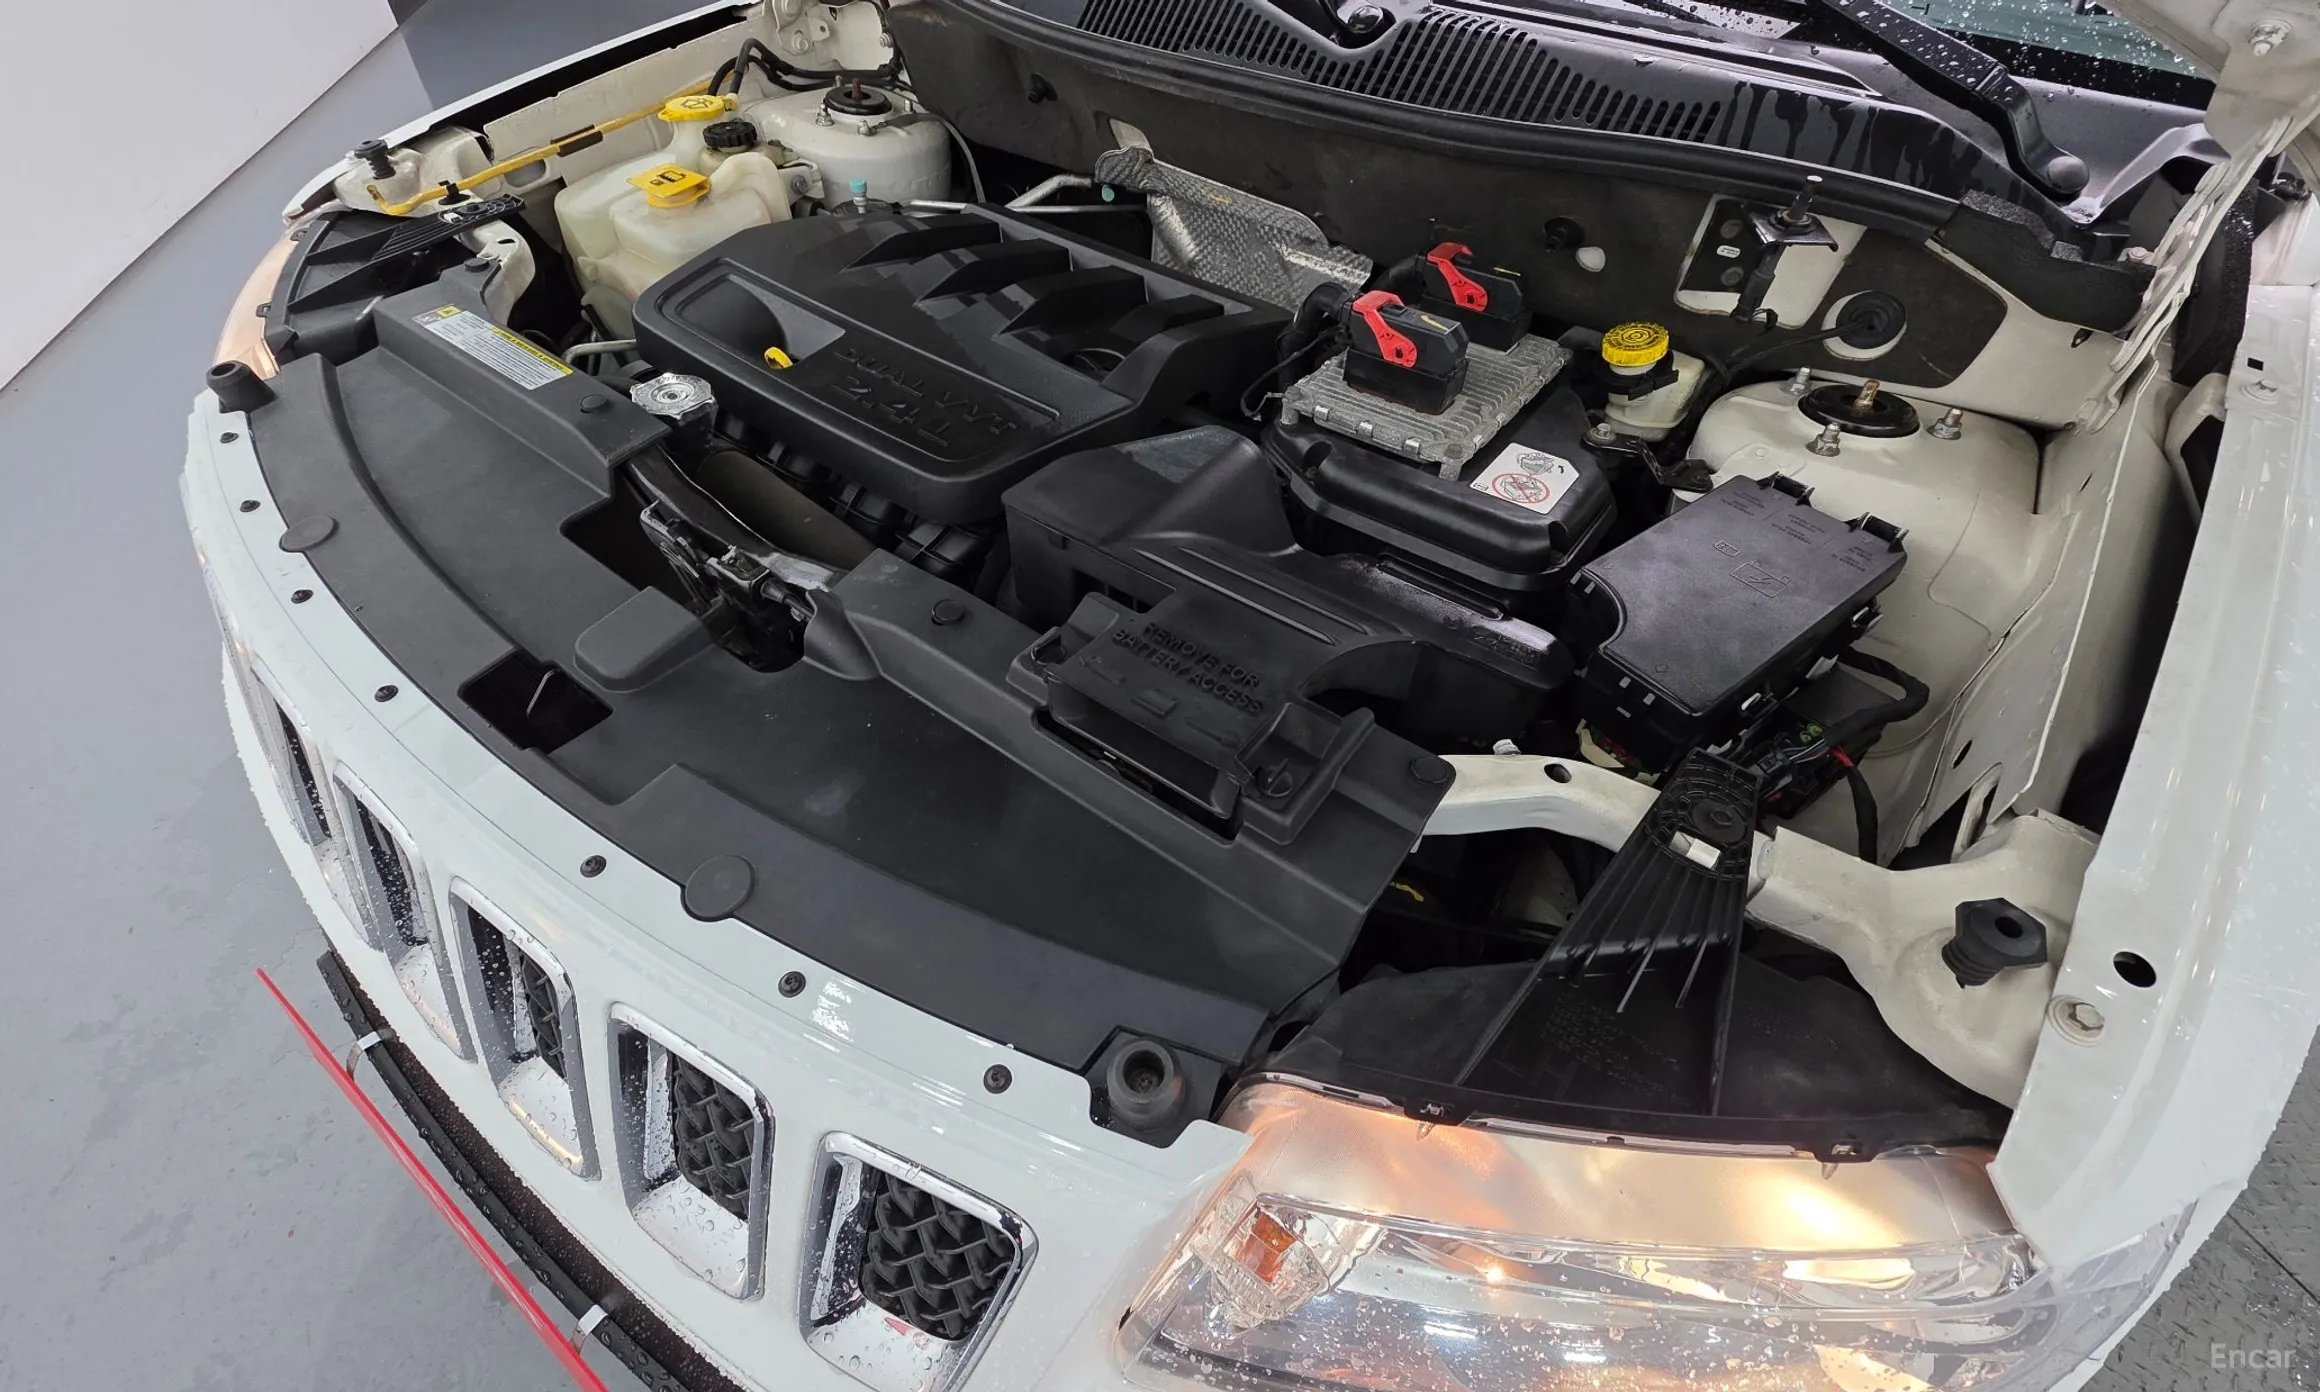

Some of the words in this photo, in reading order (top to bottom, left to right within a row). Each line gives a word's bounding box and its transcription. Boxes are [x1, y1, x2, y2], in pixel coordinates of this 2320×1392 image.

[830, 375, 951, 447] 2.4L
[833, 346, 924, 399] DUAL
[933, 391, 1020, 434] VVT
[1112, 628, 1192, 677] BATTERY
[1187, 670, 1264, 717] ACCESS
[1143, 622, 1219, 669] REMOVE
[1218, 663, 1260, 689] FOR
